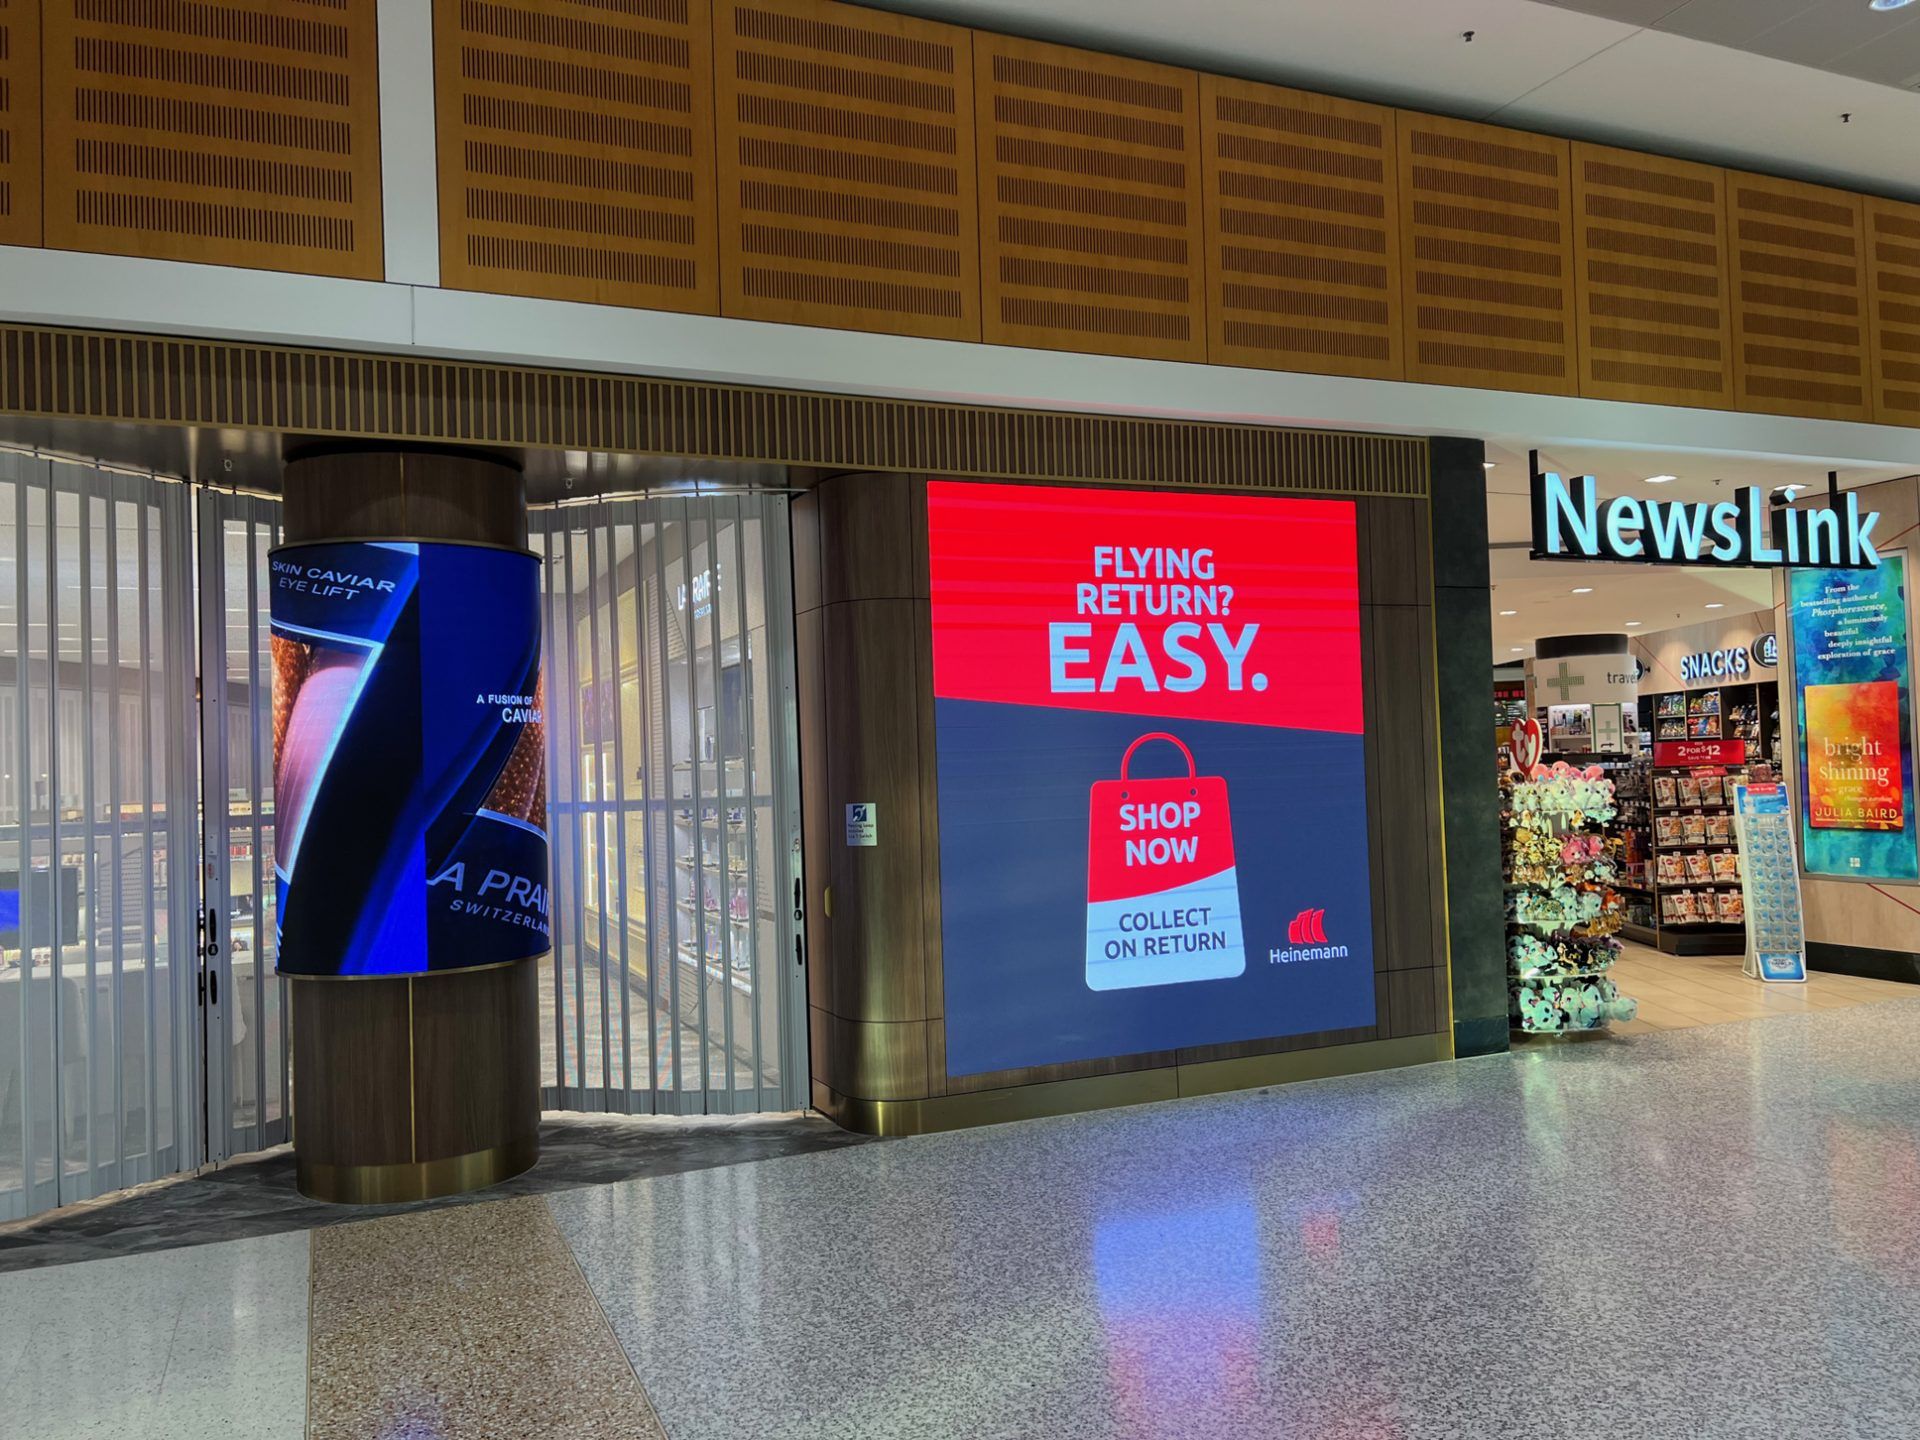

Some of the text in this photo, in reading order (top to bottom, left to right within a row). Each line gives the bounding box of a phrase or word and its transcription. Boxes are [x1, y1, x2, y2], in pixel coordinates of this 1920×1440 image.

[1545, 472, 1882, 565] NewsLink
[1094, 546, 1215, 580] FLYING
[271, 561, 396, 593] SKIN CAVIAR
[279, 577, 360, 600] EYE LIFT
[1076, 583, 1234, 616] RETURN?
[1800, 597, 1841, 608] bestselling
[1842, 594, 1868, 602] author
[1824, 586, 1846, 594] From
[1811, 603, 1887, 617] Phosphorescence,
[1844, 615, 1888, 624] luminously
[1824, 628, 1859, 637] beautiful
[1828, 636, 1893, 648] deeply insightful
[1048, 621, 1269, 693] EASY.
[1680, 647, 1746, 680] SNACKS
[1818, 651, 1861, 661] exploration
[1873, 649, 1896, 657] grace
[476, 694, 533, 705] A FUSION OF
[1824, 736, 1882, 761] bright
[1819, 761, 1889, 787] shining
[1119, 801, 1200, 831] SHOP
[1815, 808, 1898, 819] JULIA BAIRD
[1126, 836, 1199, 867] NOW
[1119, 907, 1212, 933] COLLECT
[1104, 931, 1227, 960] ON RETURN
[1269, 944, 1349, 964] Heinemann
